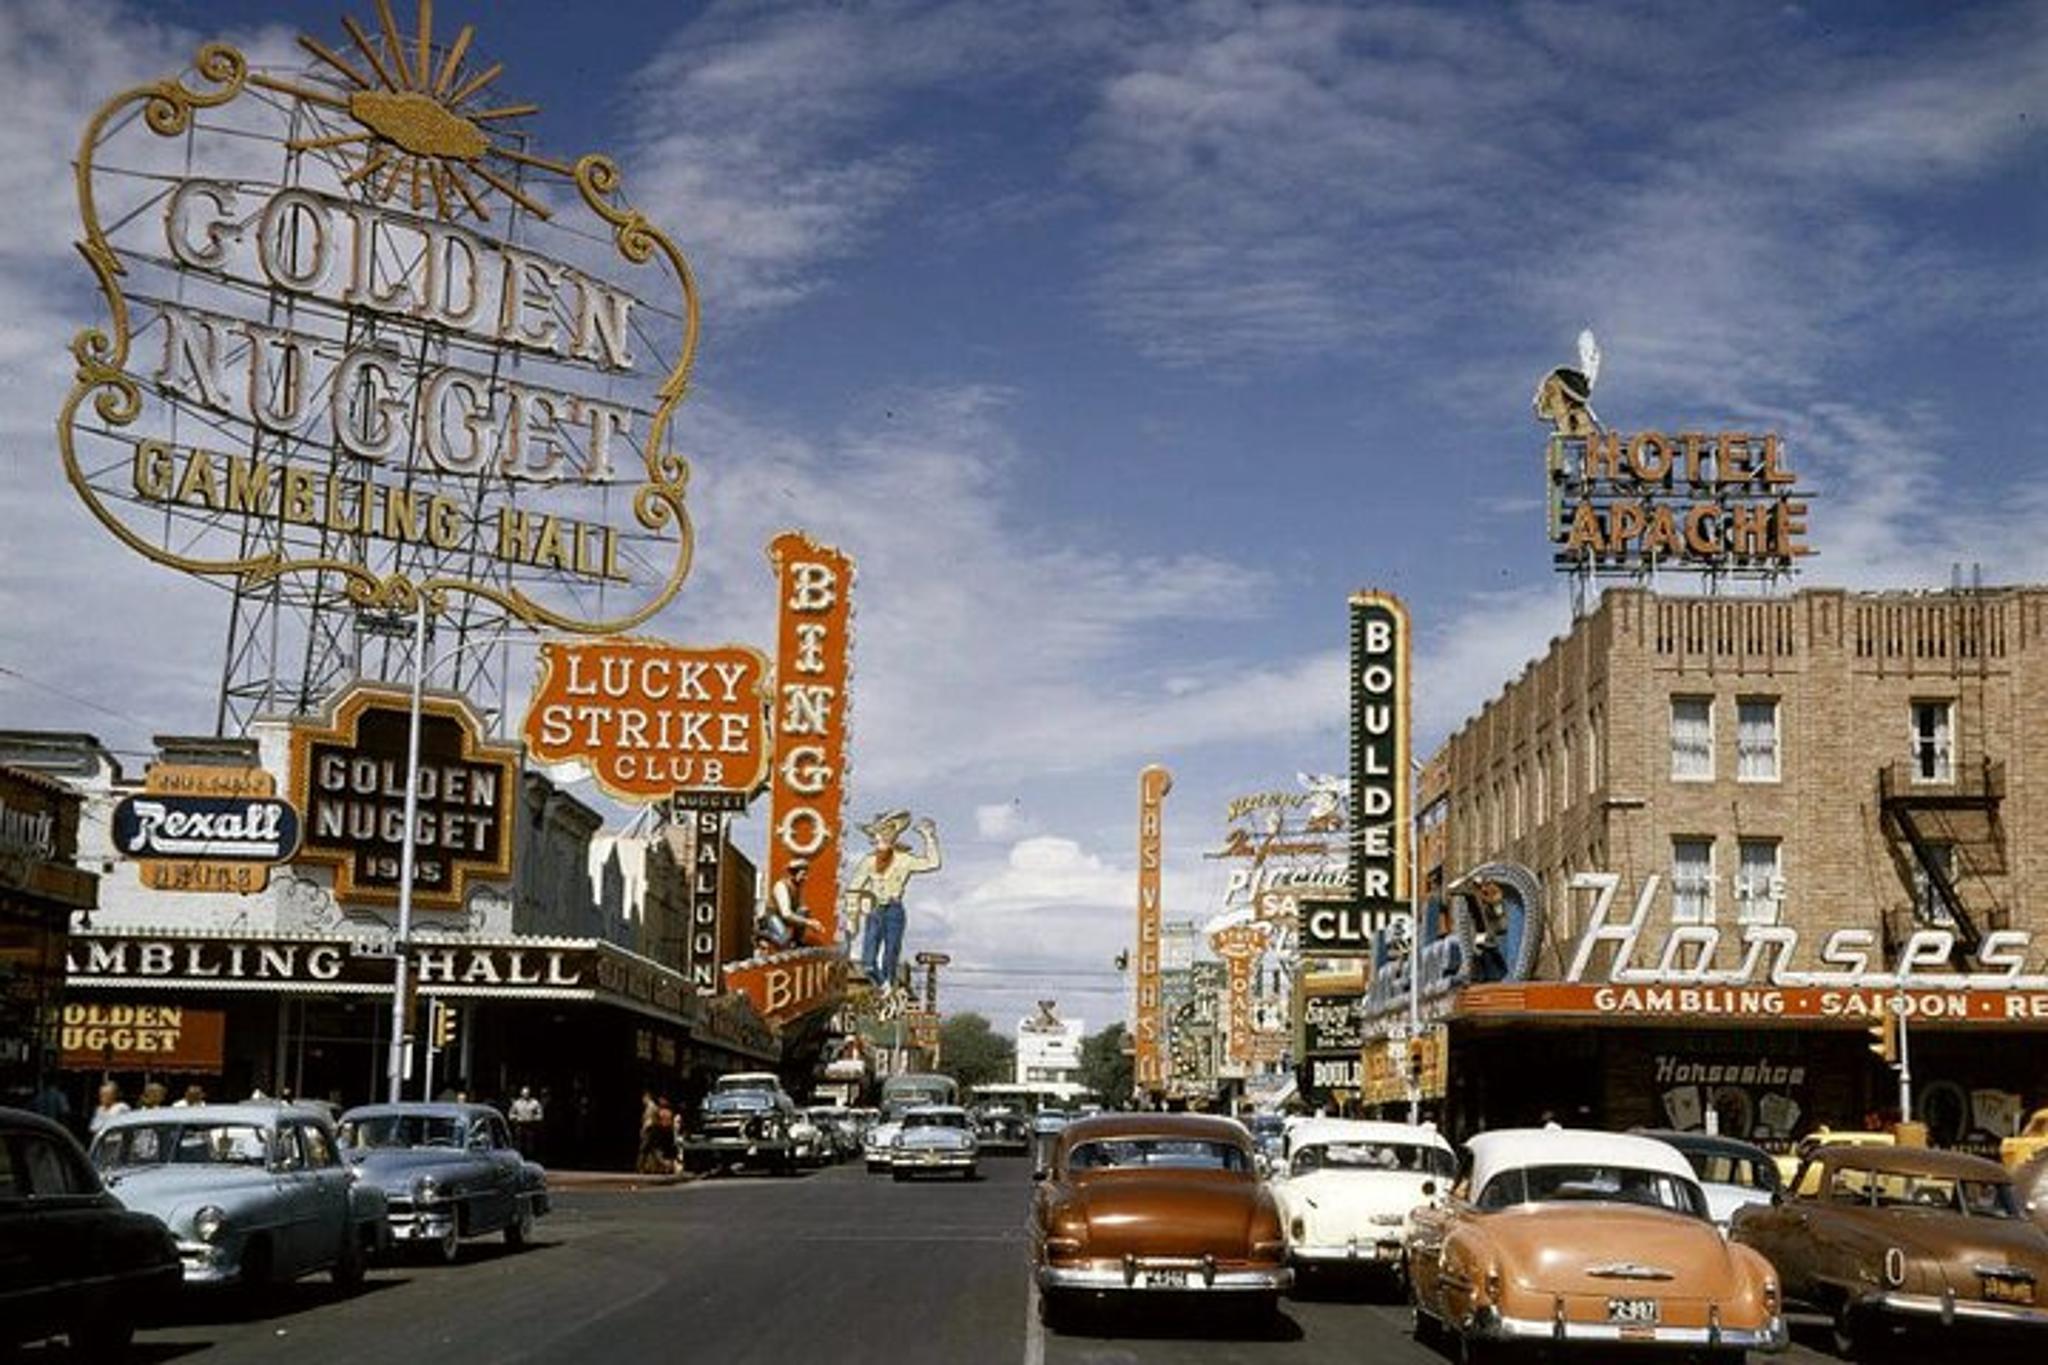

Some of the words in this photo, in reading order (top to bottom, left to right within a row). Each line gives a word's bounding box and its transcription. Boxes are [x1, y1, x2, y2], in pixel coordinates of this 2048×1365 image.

[164, 178, 637, 369] GOLDEN
[155, 307, 633, 482] NUGGET
[1585, 431, 1797, 483] HOTEL
[133, 438, 462, 550] GAMBLING
[498, 505, 631, 582] HALL
[1562, 500, 1811, 556] APACHE
[566, 654, 748, 702] LUCKY
[540, 704, 751, 754] STRIKE
[776, 560, 838, 856] BINGO
[318, 753, 496, 807] GOLDEN
[614, 756, 725, 785] CLUB
[1362, 620, 1394, 898] BOULDER
[130, 800, 283, 857] Rexall
[316, 800, 494, 851] NUGGET
[693, 812, 718, 985] SALOON
[418, 948, 581, 986] HALL
[1594, 988, 1785, 1014] GAMBLING
[1820, 993, 1968, 1017] SALOON
[1654, 1056, 1806, 1086] Horseshoe
